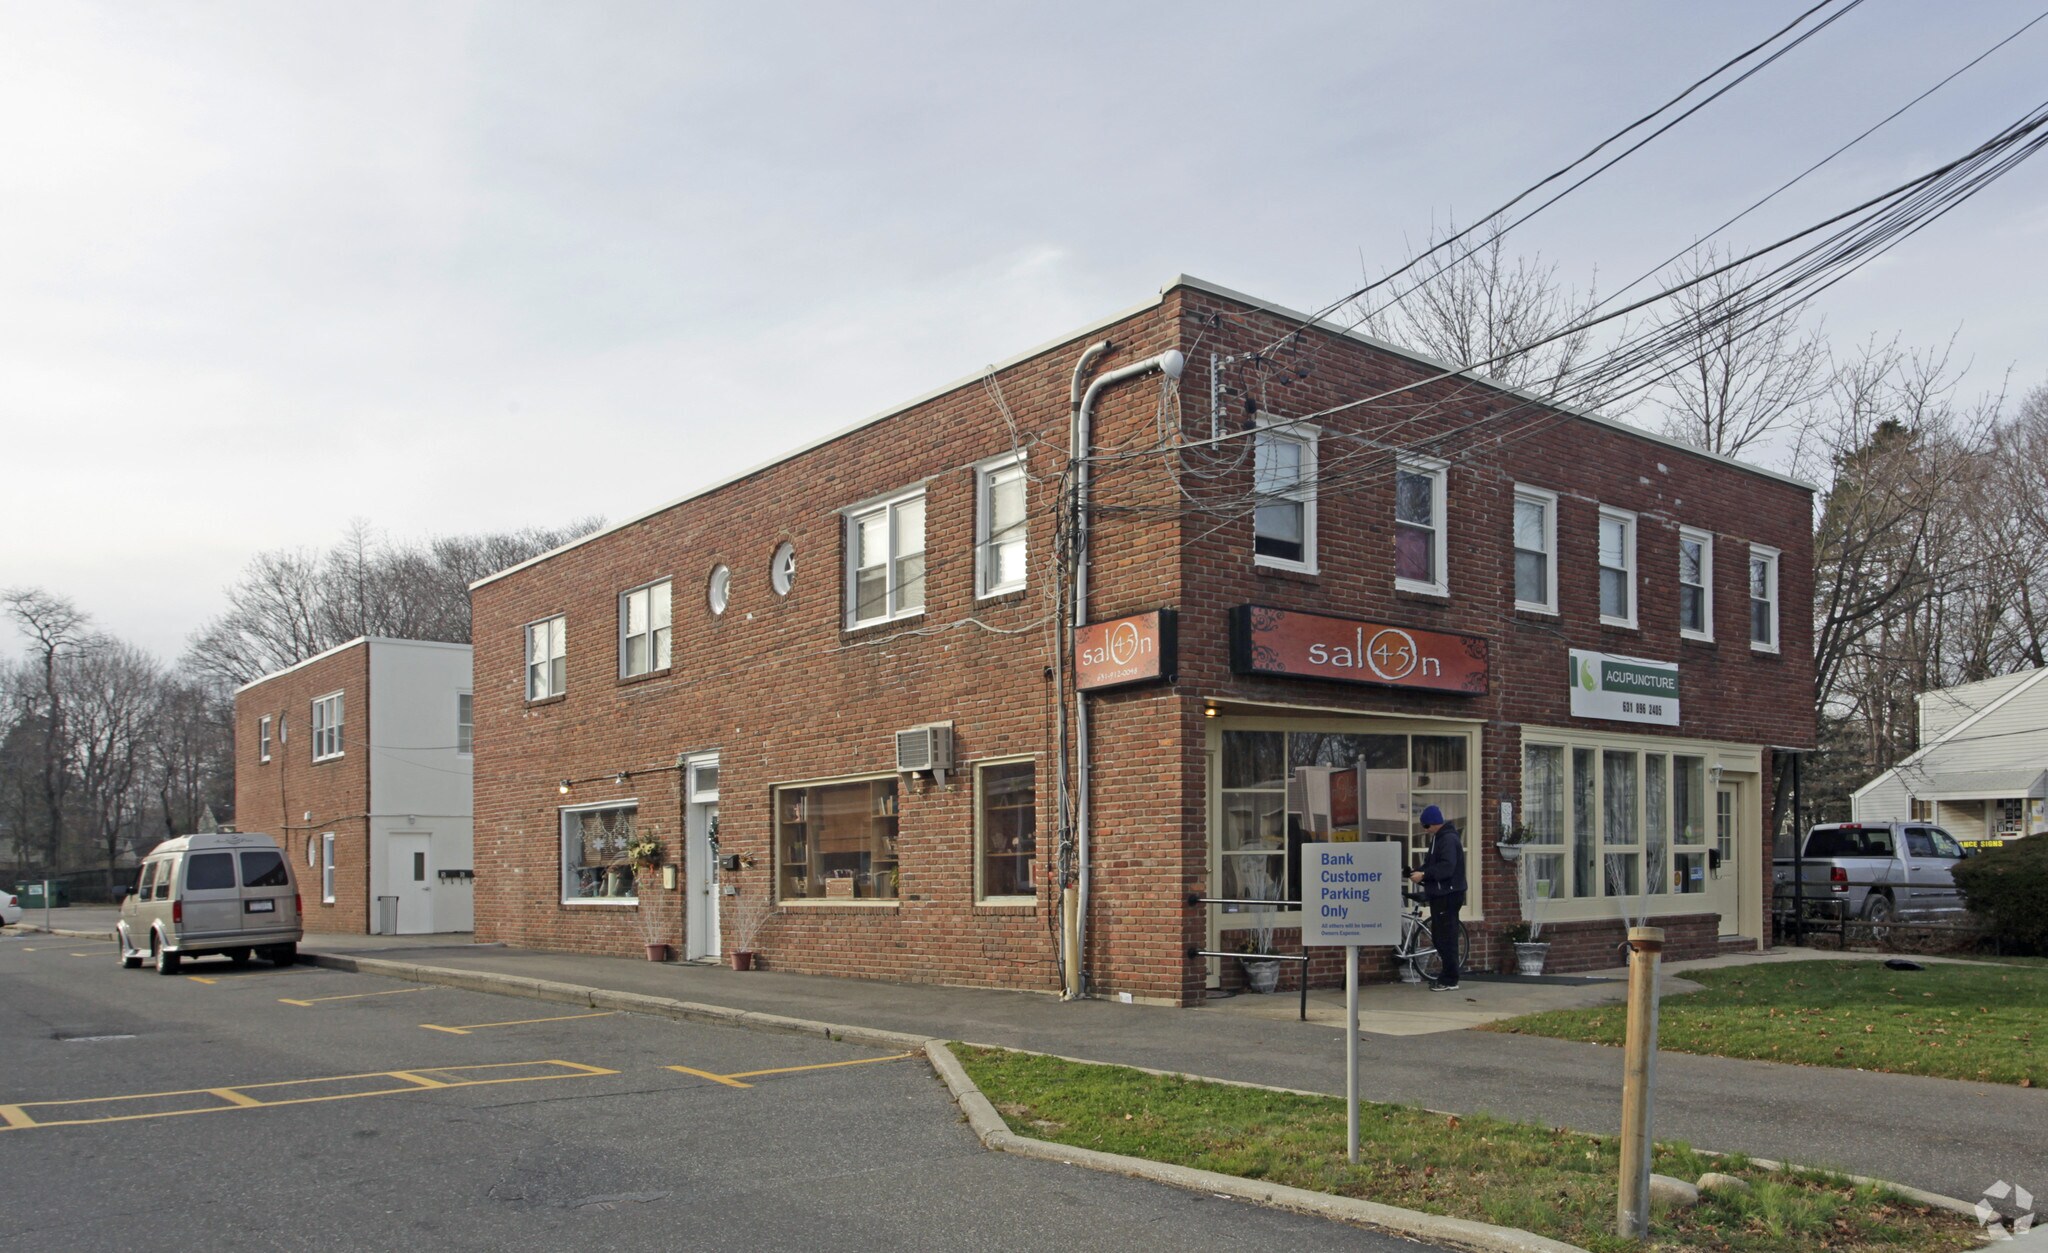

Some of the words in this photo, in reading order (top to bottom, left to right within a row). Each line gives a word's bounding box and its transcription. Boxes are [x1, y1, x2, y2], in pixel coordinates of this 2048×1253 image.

[1114, 635, 1134, 656] 45
[1373, 643, 1410, 671] 45
[1606, 670, 1675, 689] ACUPUNCTURE
[1622, 701, 1633, 713] 631
[1635, 702, 1646, 714] 896
[1980, 840, 2003, 848] SIGNS
[1321, 853, 1354, 865] Bank
[1321, 870, 1383, 883] Customer
[1321, 887, 1370, 902] Parking
[1321, 904, 1349, 919] Only
